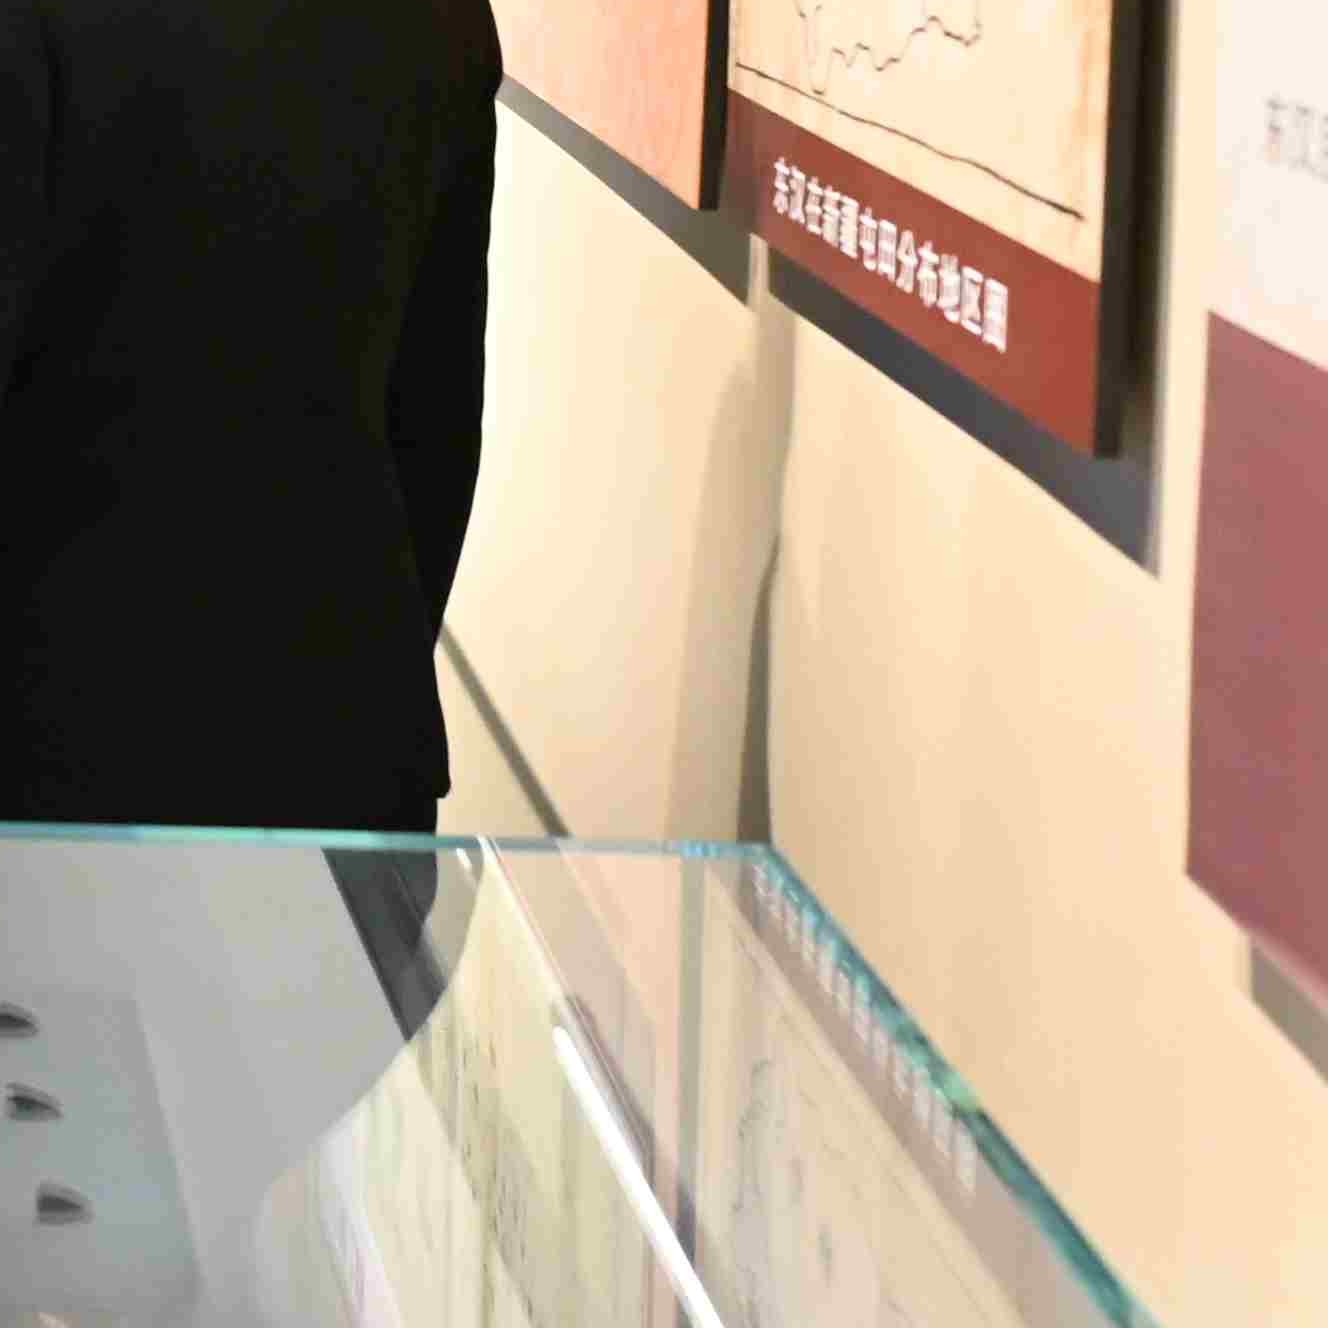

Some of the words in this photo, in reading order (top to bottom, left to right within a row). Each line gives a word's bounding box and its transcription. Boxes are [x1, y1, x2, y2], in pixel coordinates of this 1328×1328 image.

[772, 155, 1009, 354] 东汉在新疆屯田分布地区图
